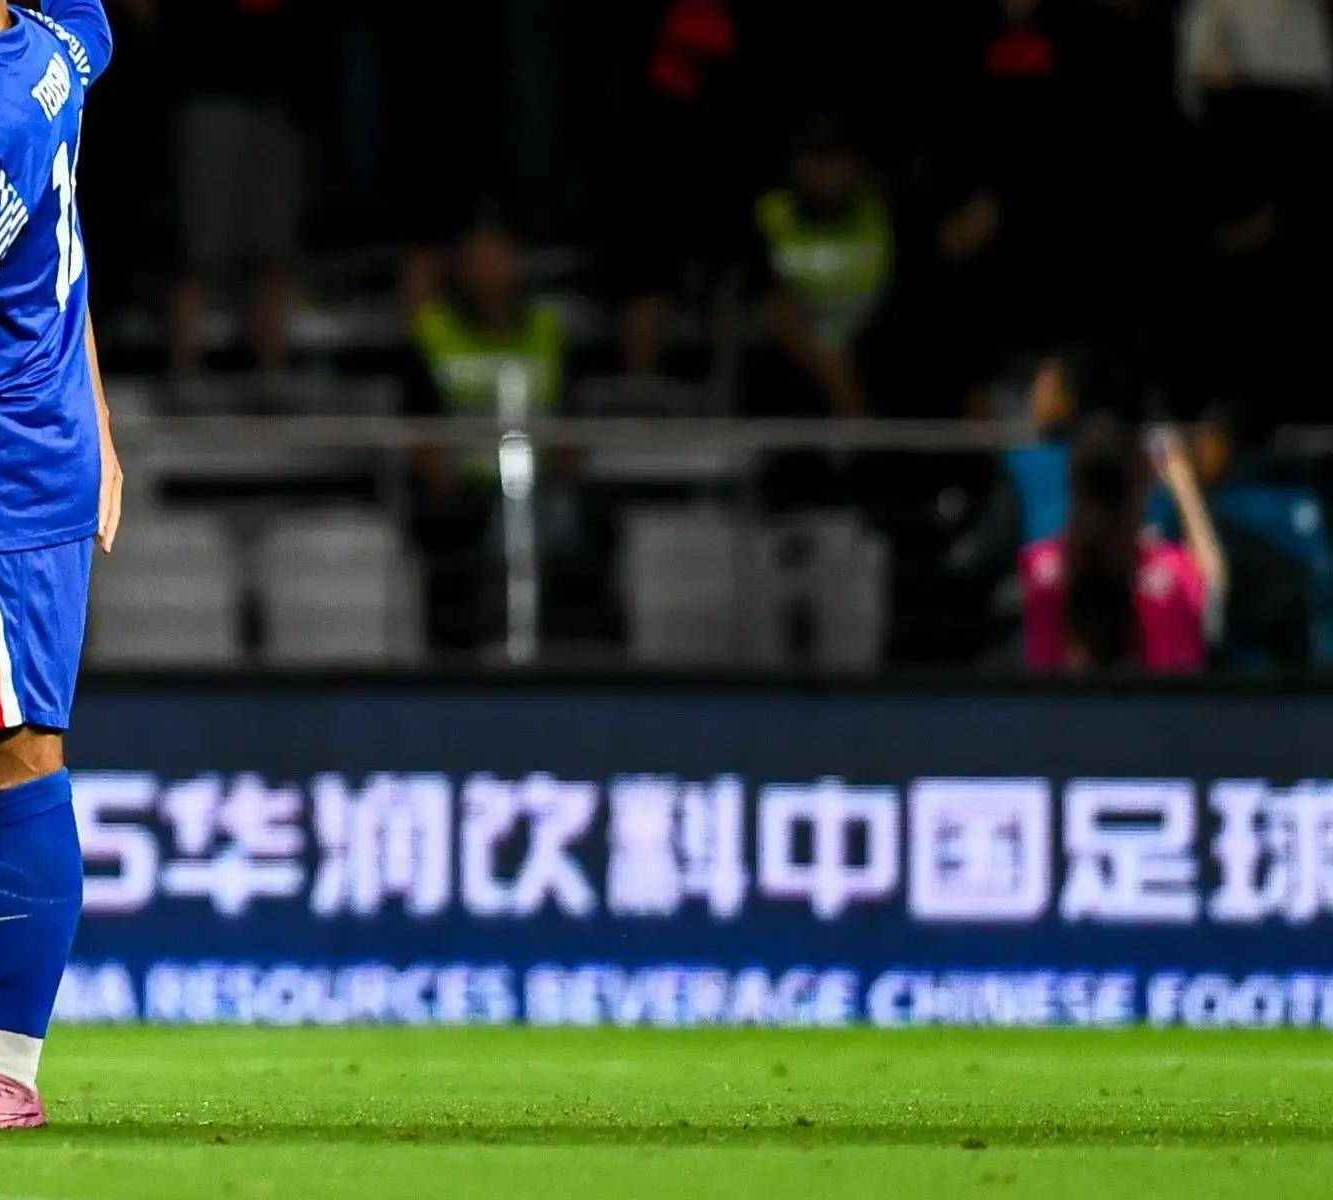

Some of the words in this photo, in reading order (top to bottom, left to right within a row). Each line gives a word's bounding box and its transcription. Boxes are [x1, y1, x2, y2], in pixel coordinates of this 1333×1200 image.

[144, 962, 517, 1027] RESOURCES
[524, 964, 862, 1028] BEVERAGE
[867, 967, 1137, 1029] CHINESE
